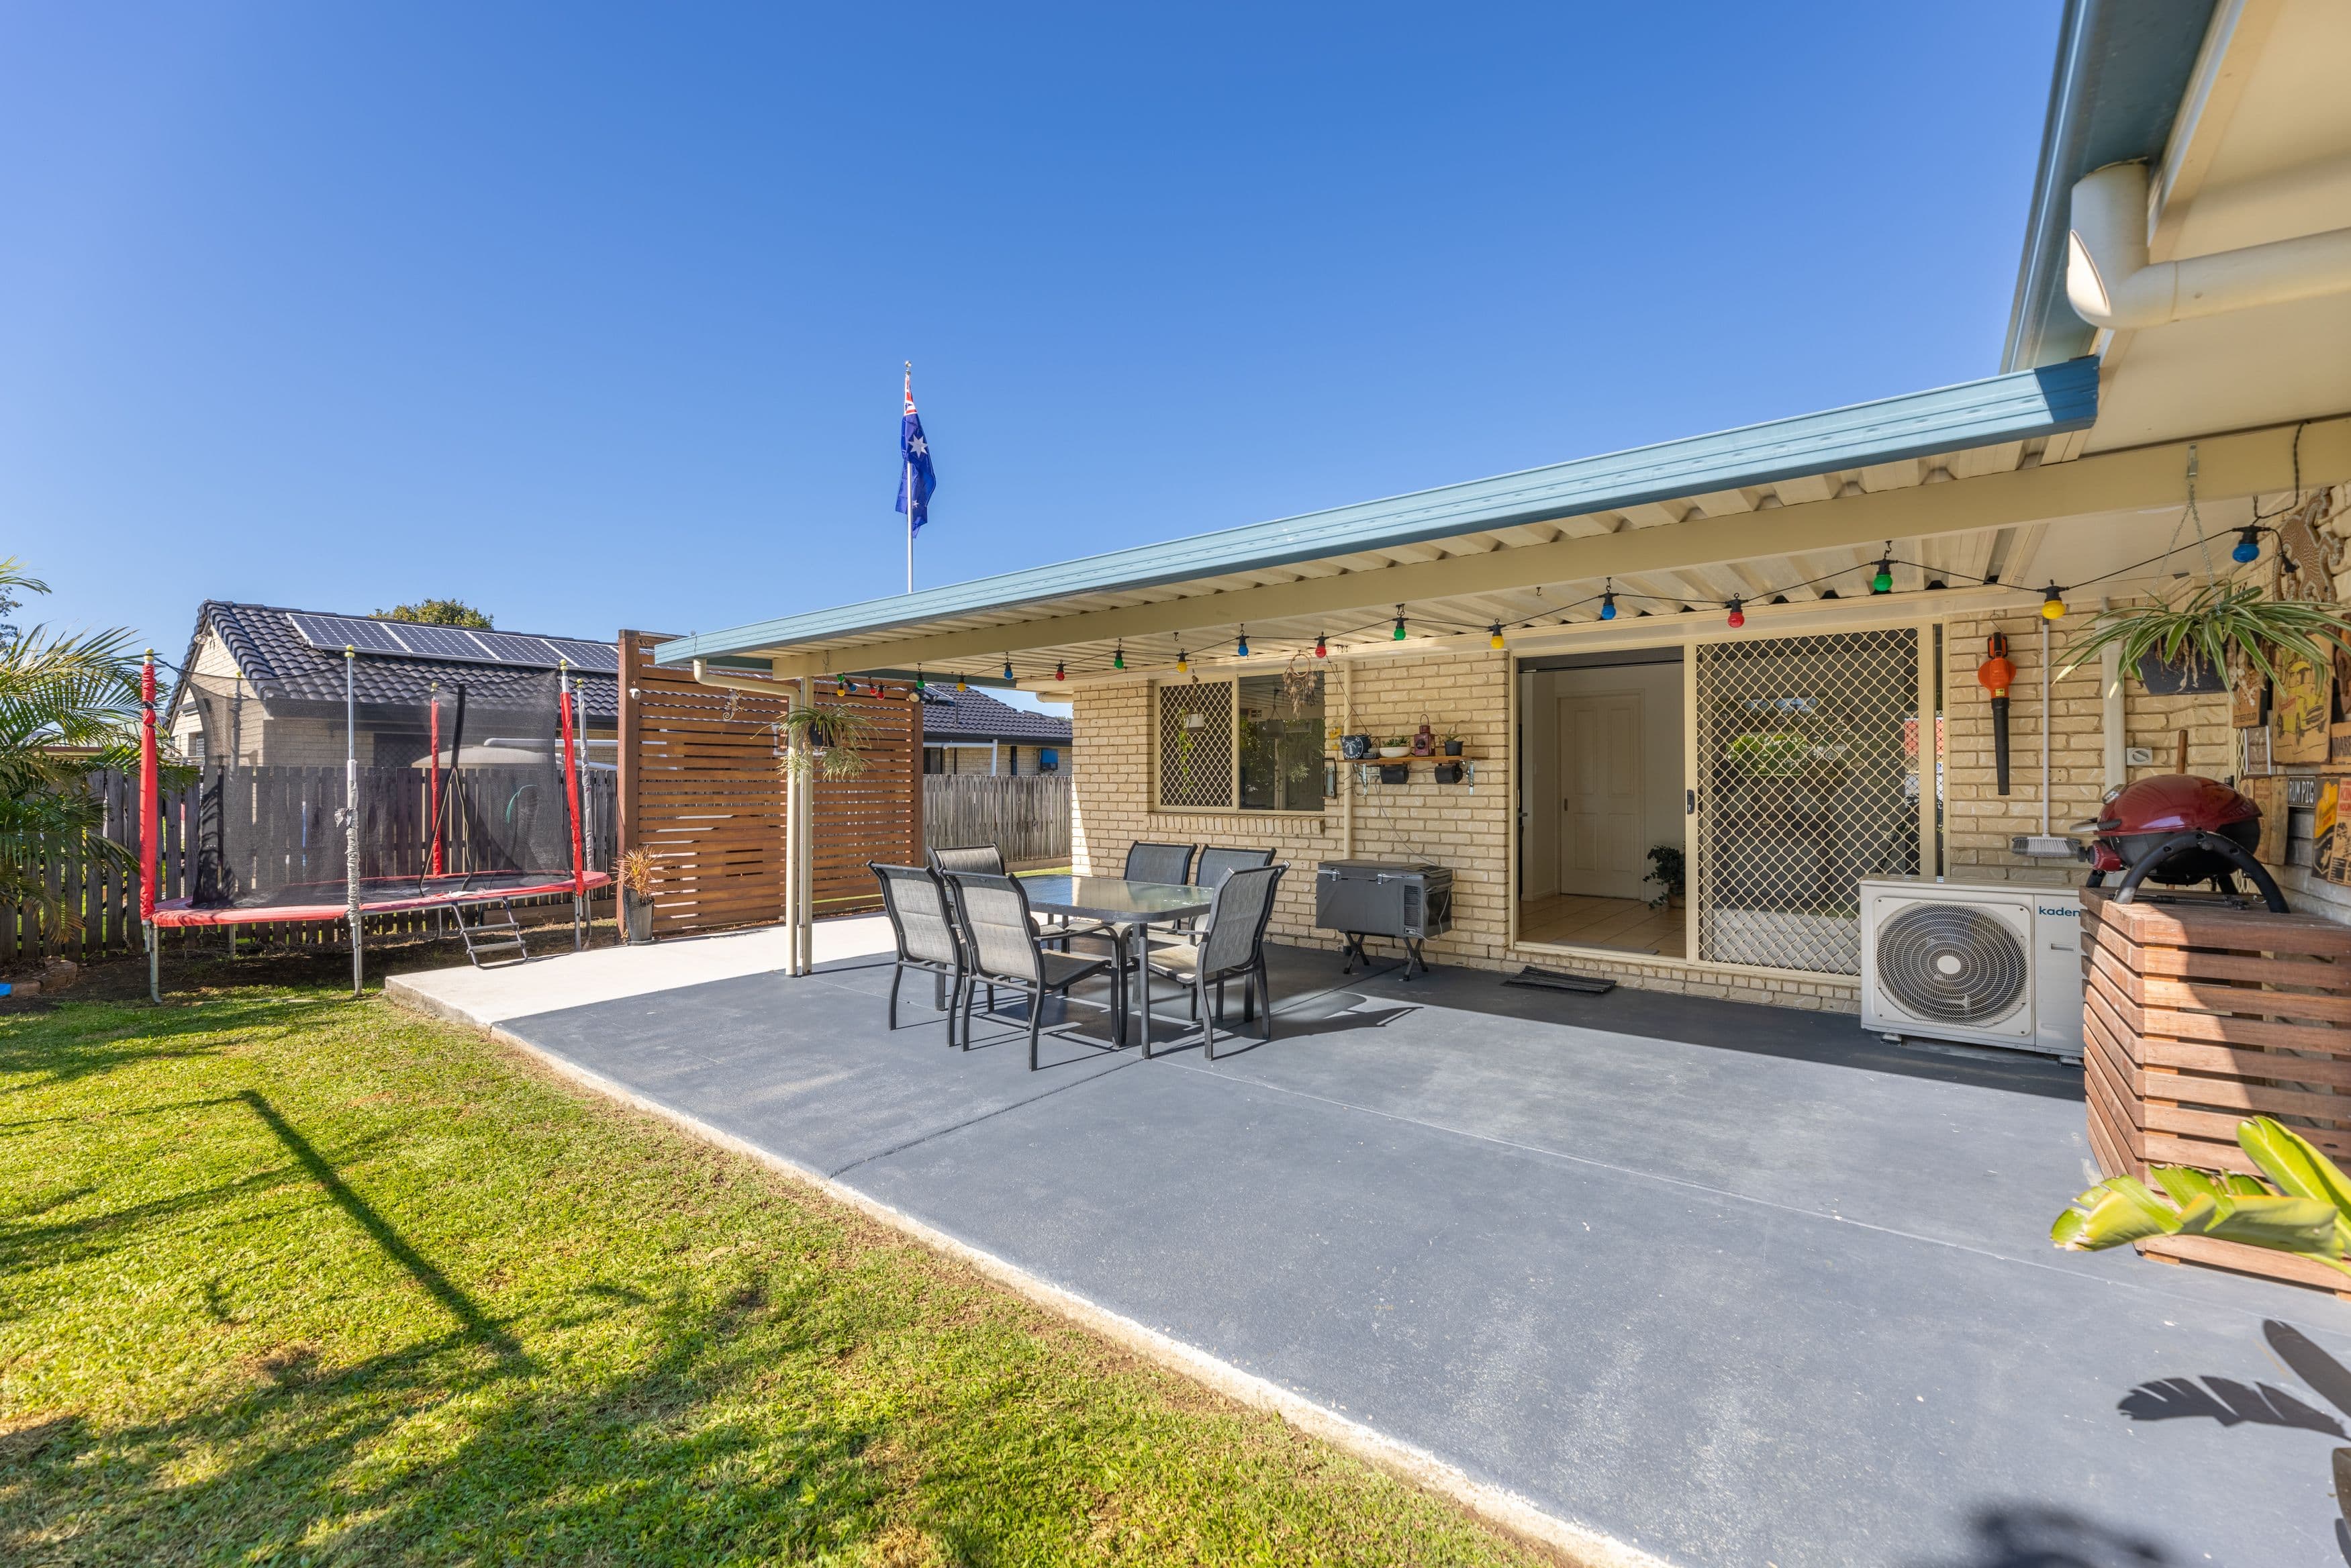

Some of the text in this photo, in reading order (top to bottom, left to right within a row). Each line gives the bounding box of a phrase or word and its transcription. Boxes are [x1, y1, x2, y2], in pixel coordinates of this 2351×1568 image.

[2289, 781, 2314, 803] RUM PIG
[2039, 906, 2080, 917] kaden
